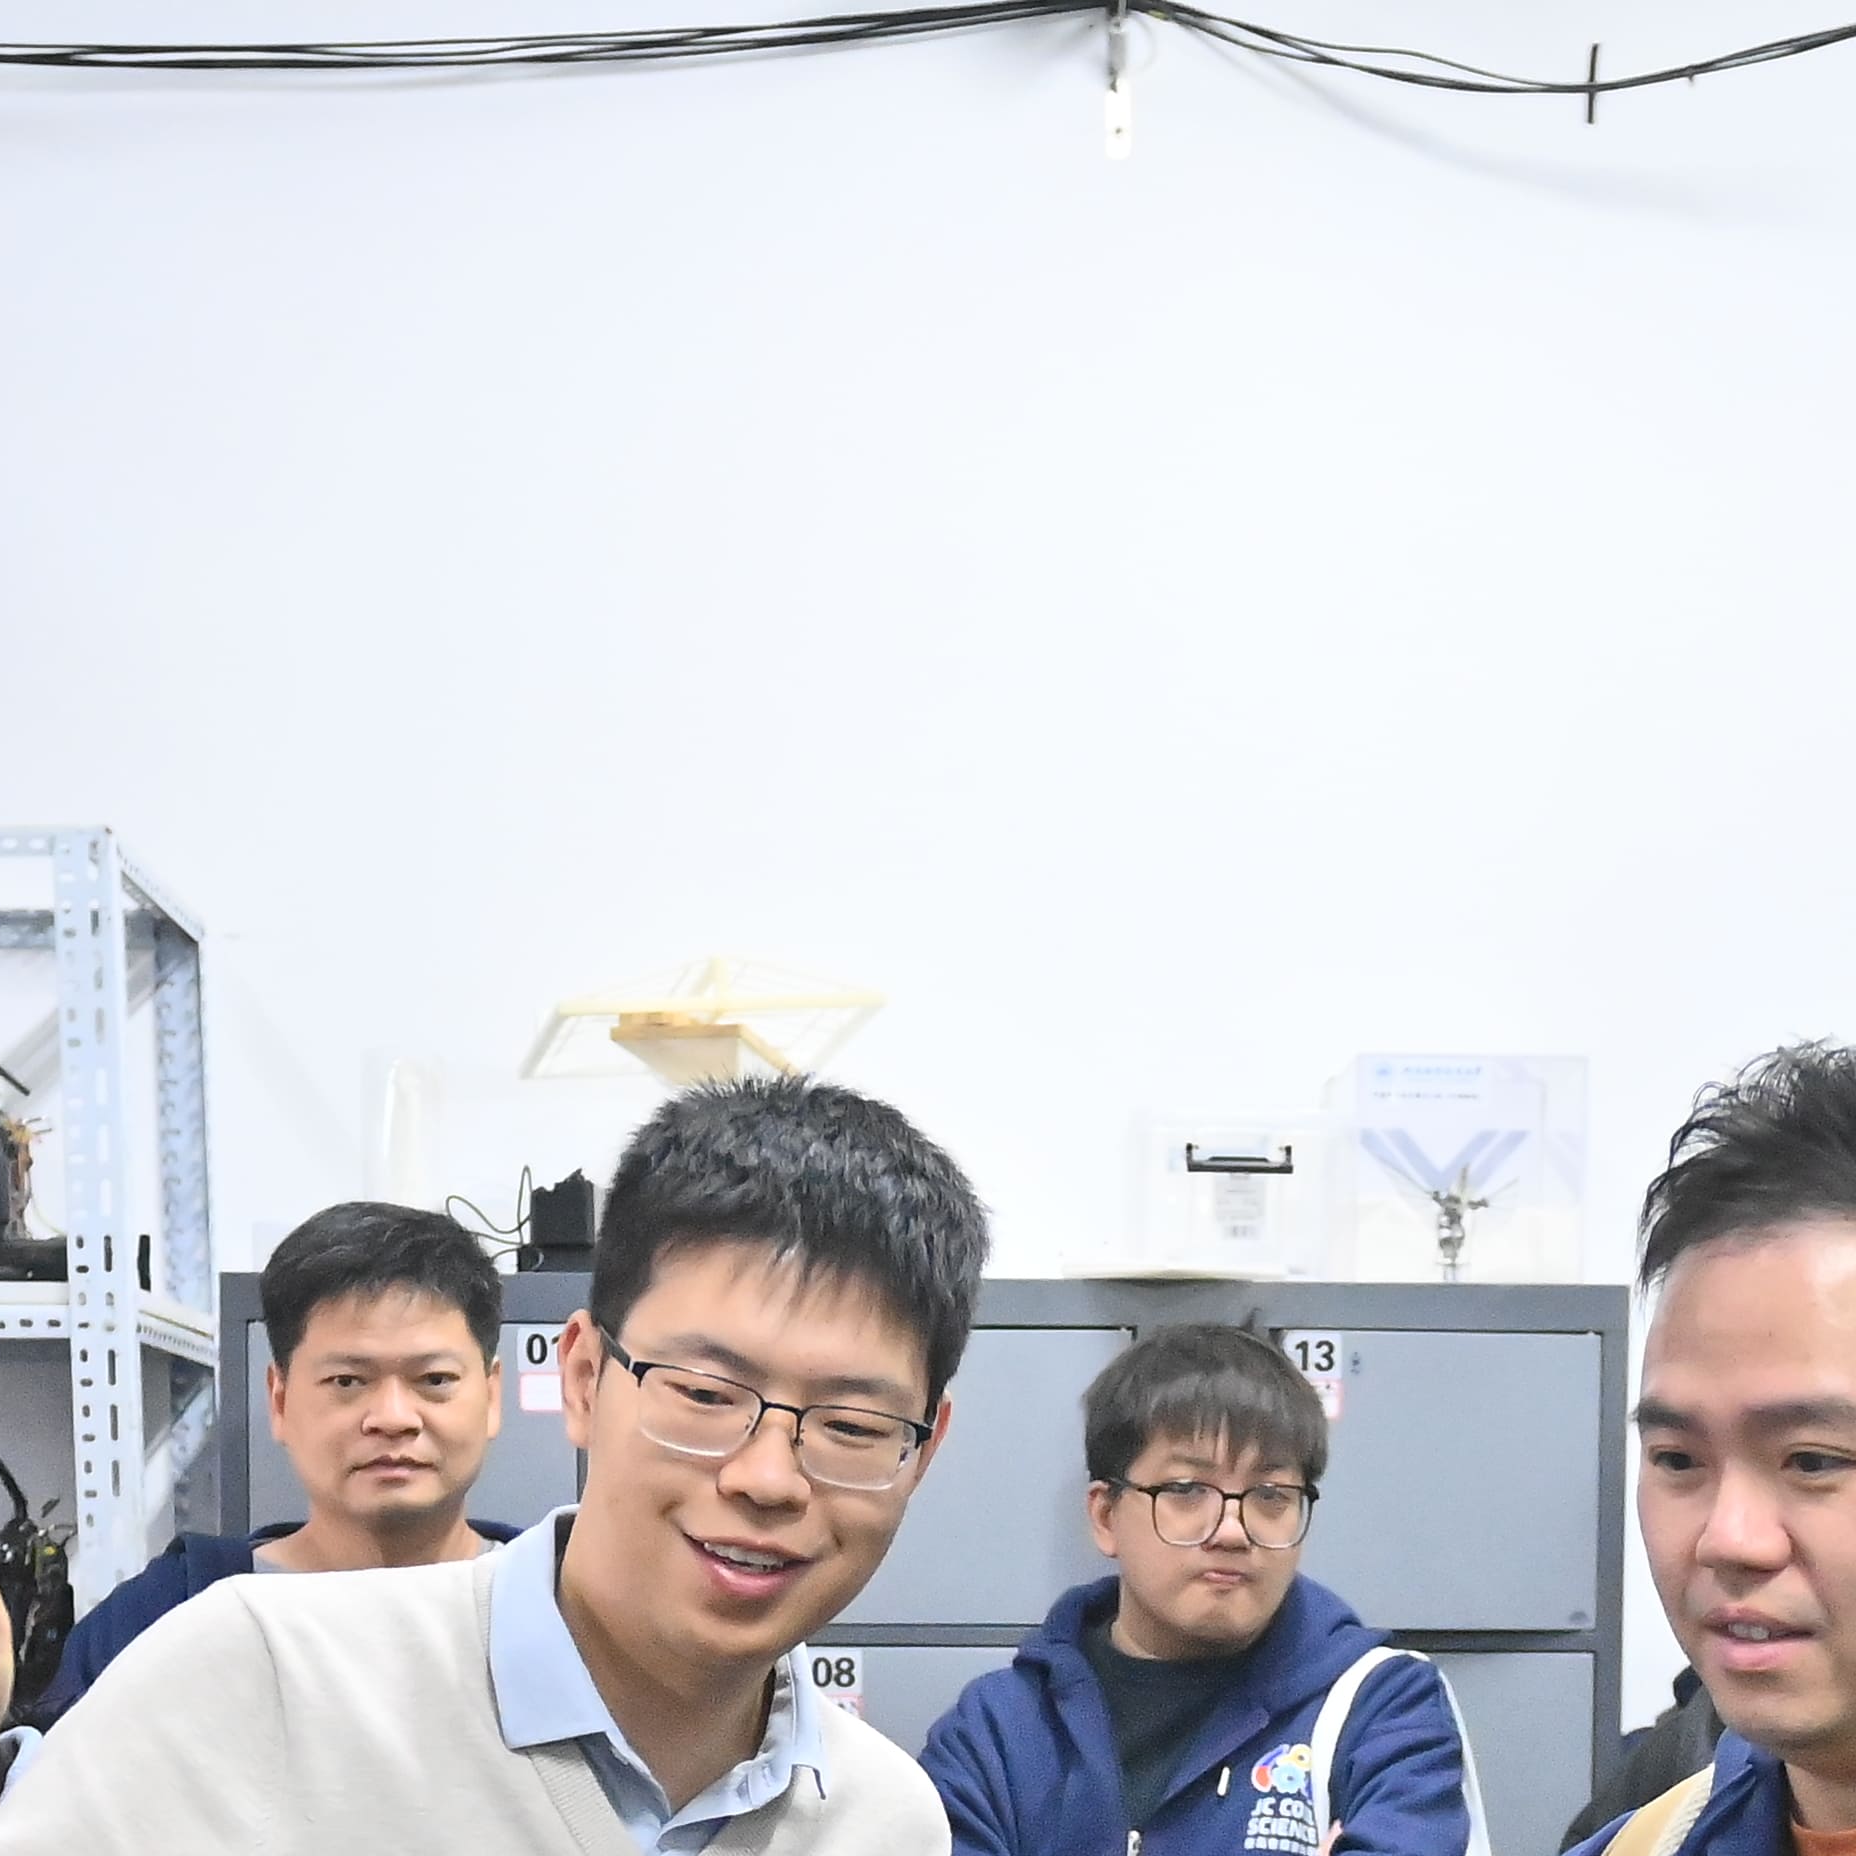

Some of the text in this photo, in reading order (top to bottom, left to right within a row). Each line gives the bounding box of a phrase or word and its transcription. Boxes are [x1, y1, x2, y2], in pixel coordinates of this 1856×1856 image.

[1295, 1340, 1335, 1372] 13
[812, 1657, 856, 1688] 08
[1251, 1797, 1276, 1816] JC
